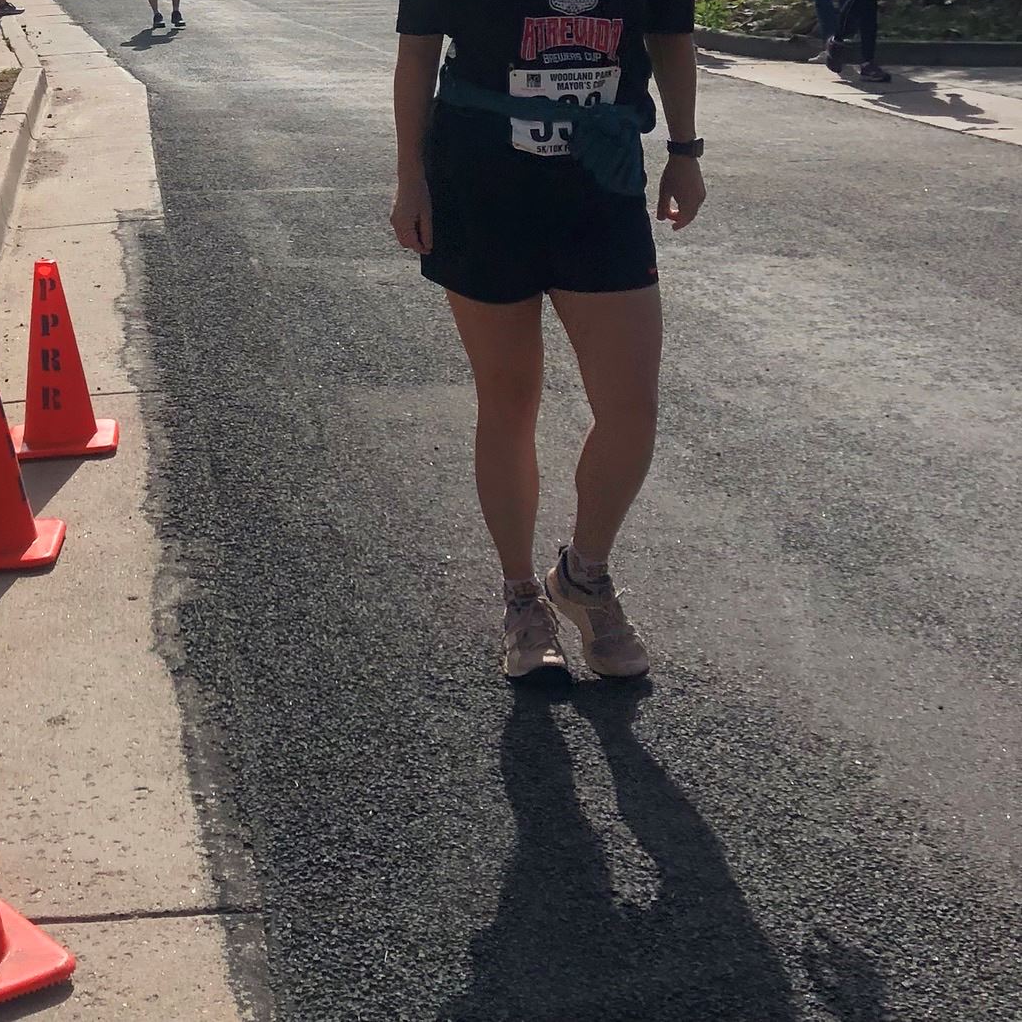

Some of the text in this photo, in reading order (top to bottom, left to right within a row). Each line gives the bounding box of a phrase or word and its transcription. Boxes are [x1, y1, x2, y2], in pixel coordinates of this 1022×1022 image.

[584, 52, 601, 64] CUP
[550, 72, 593, 82] WOODLAND
[557, 81, 592, 91] MAYOR'S
[536, 145, 563, 154] 5K/10K
[39, 278, 62, 410] PPRR
